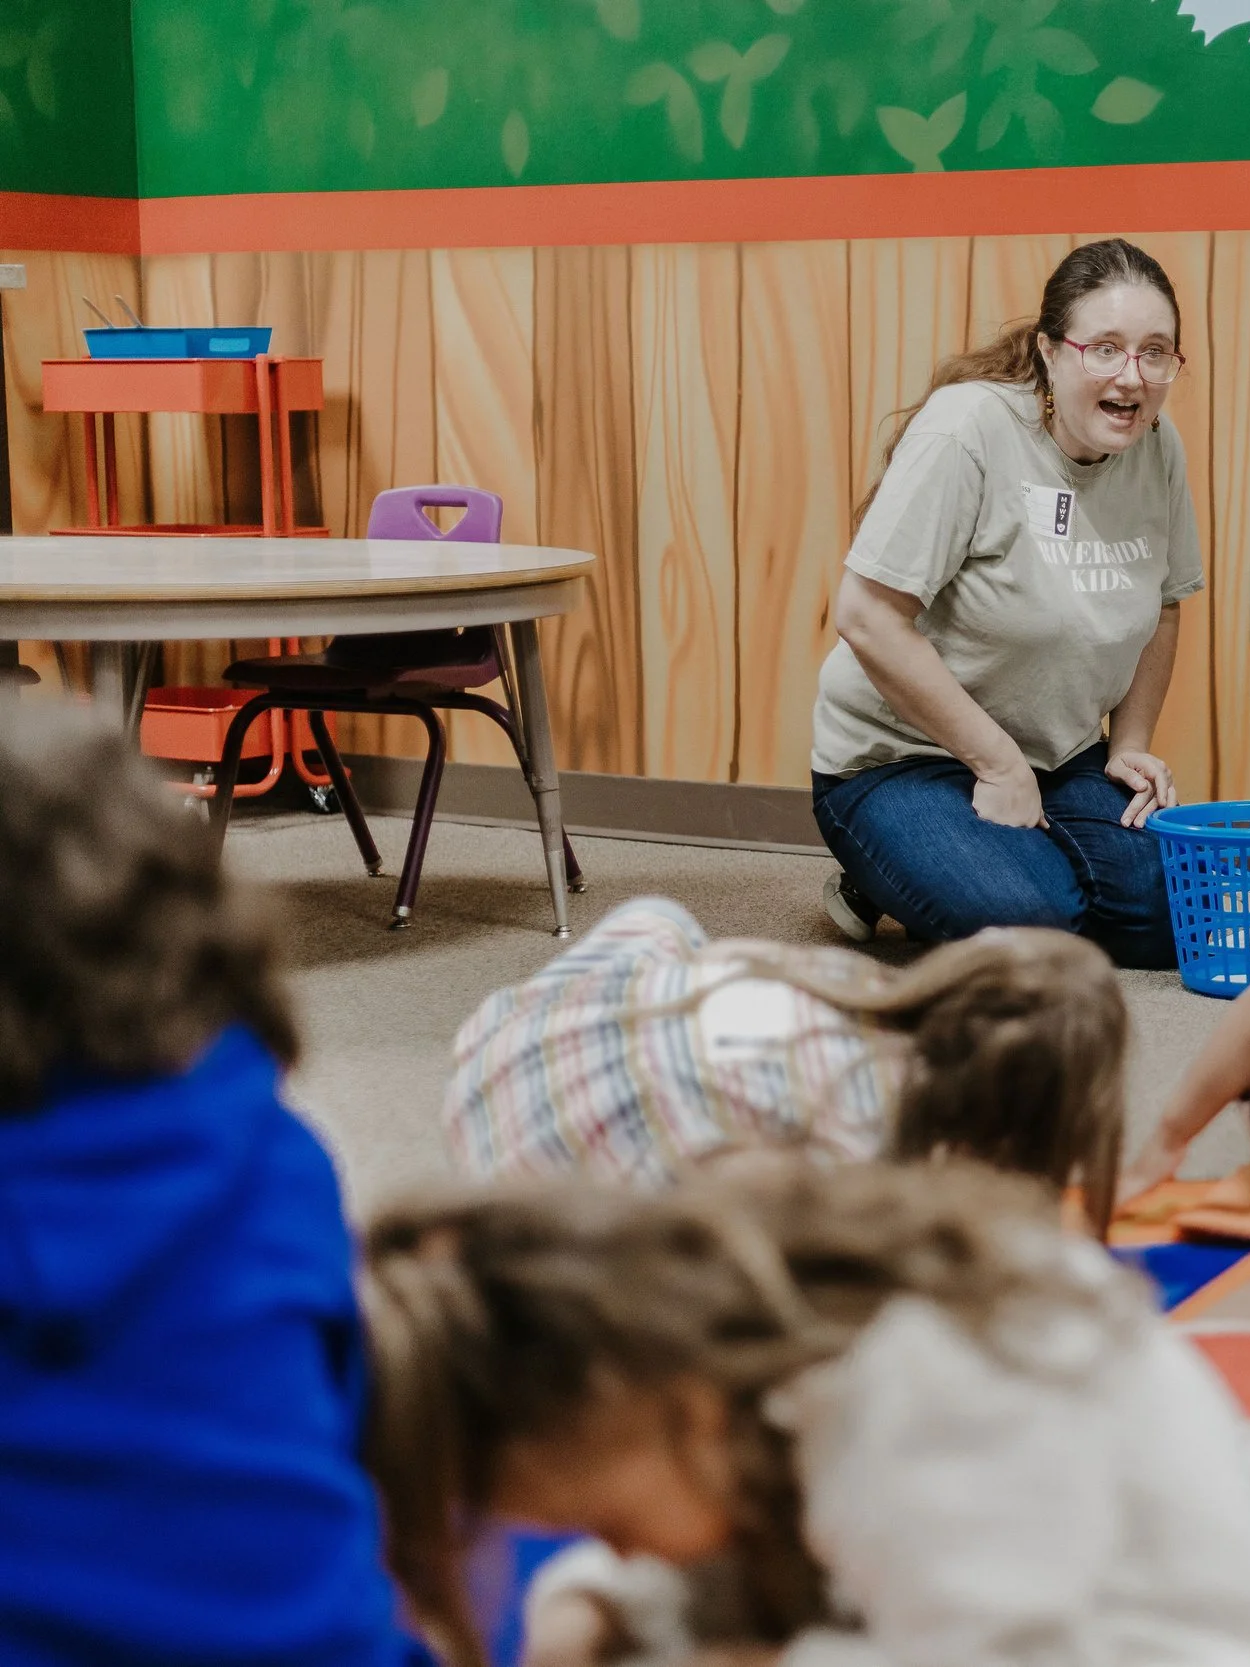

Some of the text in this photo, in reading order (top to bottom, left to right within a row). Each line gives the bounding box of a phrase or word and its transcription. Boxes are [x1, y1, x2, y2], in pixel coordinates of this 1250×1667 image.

[1059, 496, 1068, 520] M4W7
[1037, 536, 1153, 565] RIVERSIDE
[1070, 567, 1133, 592] KIDS
